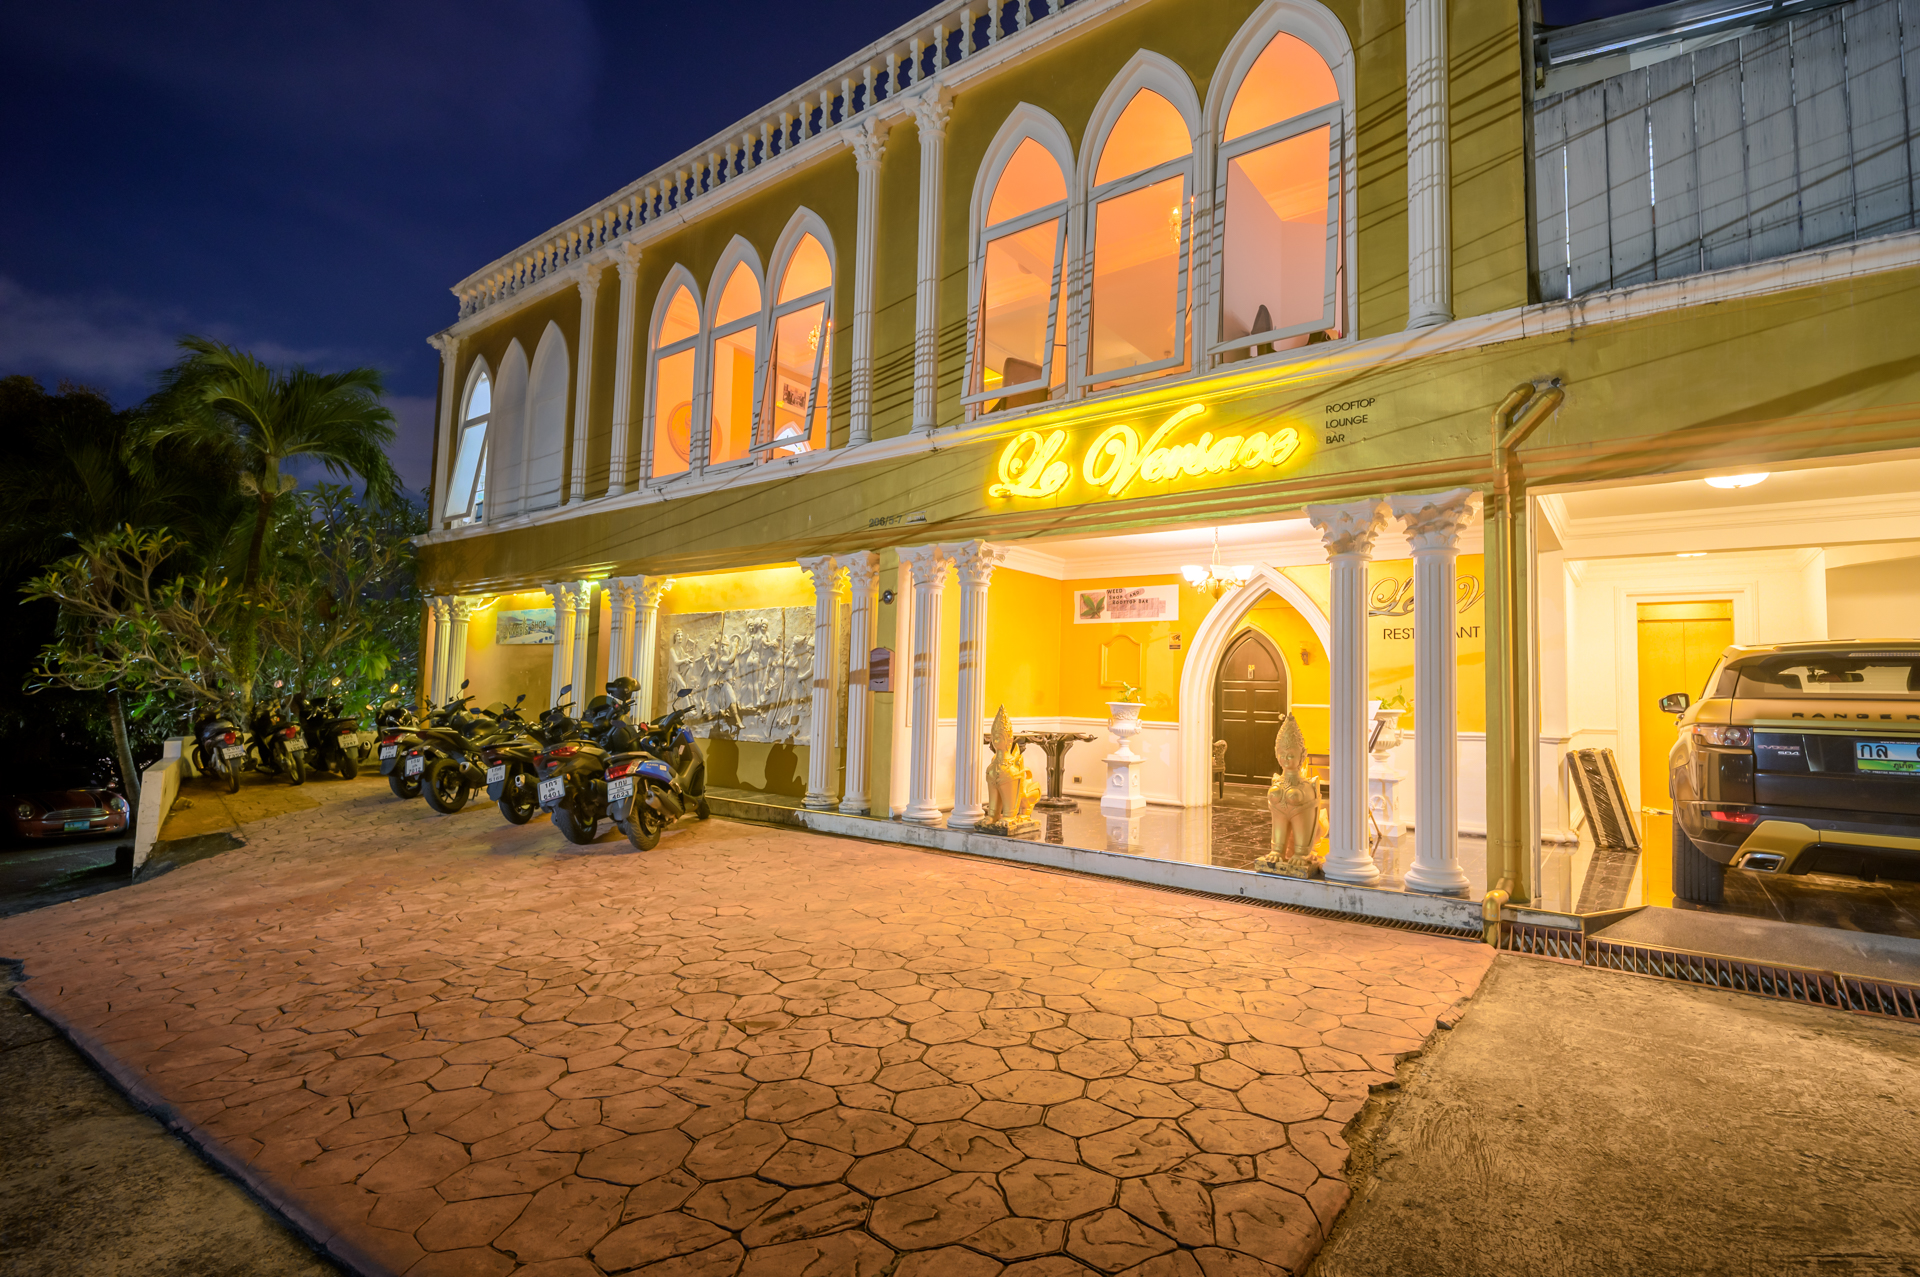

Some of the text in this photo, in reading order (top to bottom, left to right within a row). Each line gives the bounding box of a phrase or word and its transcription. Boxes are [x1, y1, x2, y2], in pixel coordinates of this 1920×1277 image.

[1326, 398, 1375, 413] ROOFTOP
[1326, 414, 1368, 428] LOUNGE
[1326, 434, 1345, 444] BAR
[988, 403, 1299, 498] Le Versace
[531, 620, 547, 630] SHOP
[1383, 626, 1480, 640] RESTNT
[1792, 712, 1892, 720] RANGE
[1860, 744, 1889, 759] กล
